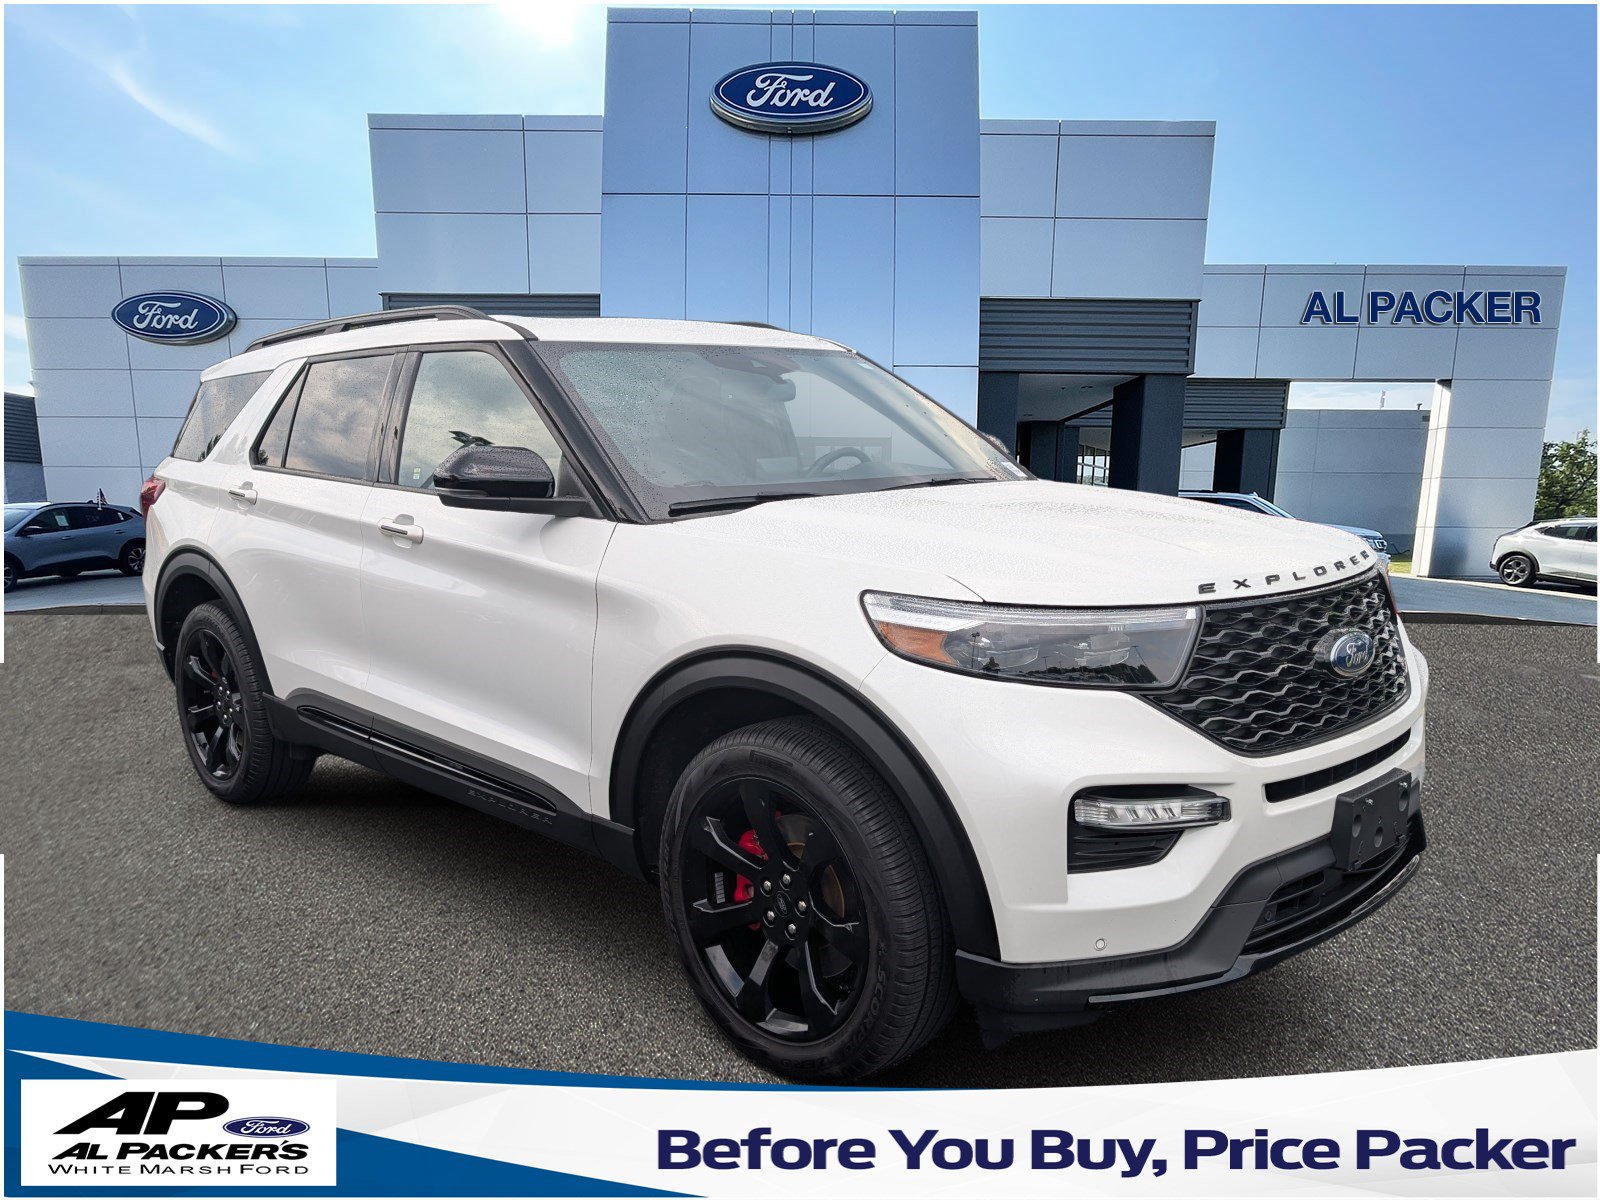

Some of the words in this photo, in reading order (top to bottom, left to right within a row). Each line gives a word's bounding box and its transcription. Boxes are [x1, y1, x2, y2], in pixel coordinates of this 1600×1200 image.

[746, 73, 836, 108] Ford
[133, 301, 199, 329] Ford
[1301, 290, 1360, 324] AL
[1368, 290, 1542, 325] PACKER
[1198, 549, 1370, 595] EXPLORER
